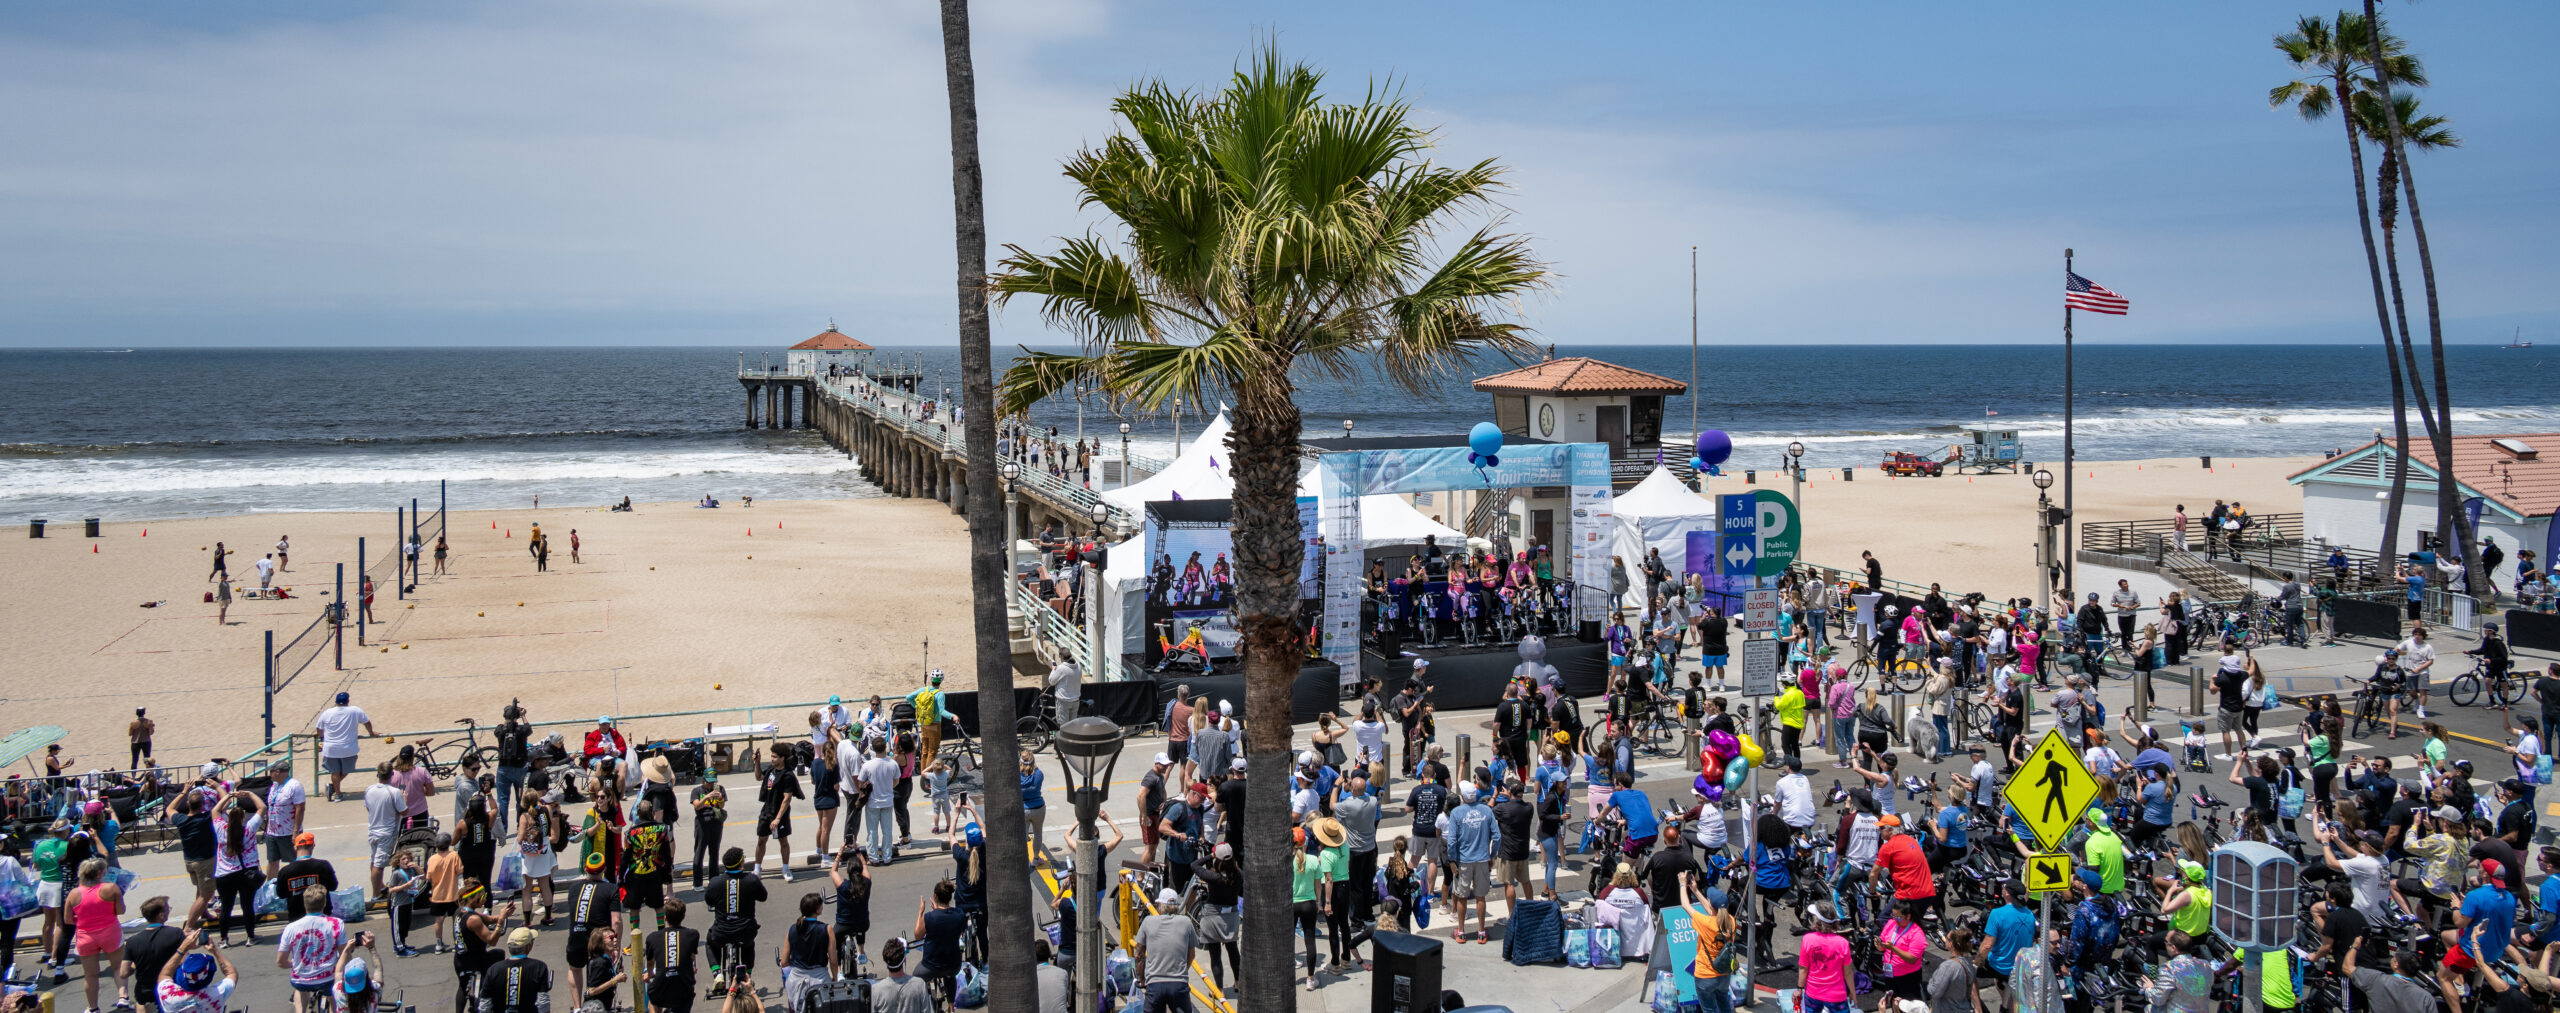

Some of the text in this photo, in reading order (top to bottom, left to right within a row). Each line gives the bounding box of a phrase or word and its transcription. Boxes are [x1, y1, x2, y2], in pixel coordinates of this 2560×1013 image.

[1625, 464, 1654, 472] OPERATIONS
[1737, 500, 1743, 511] 5
[1725, 516, 1754, 528] HOUR
[1756, 501, 1787, 558] P
[1766, 540, 1789, 549] Public
[1747, 602, 1775, 610] CLOSED
[582, 883, 593, 901] ONE
[729, 879, 737, 894] ONE
[729, 895, 737, 913] LOVE
[577, 901, 588, 923] LOVE
[668, 931, 677, 946] ONE
[668, 947, 677, 967] LOVE
[509, 966, 519, 1006] ONE LOVE
